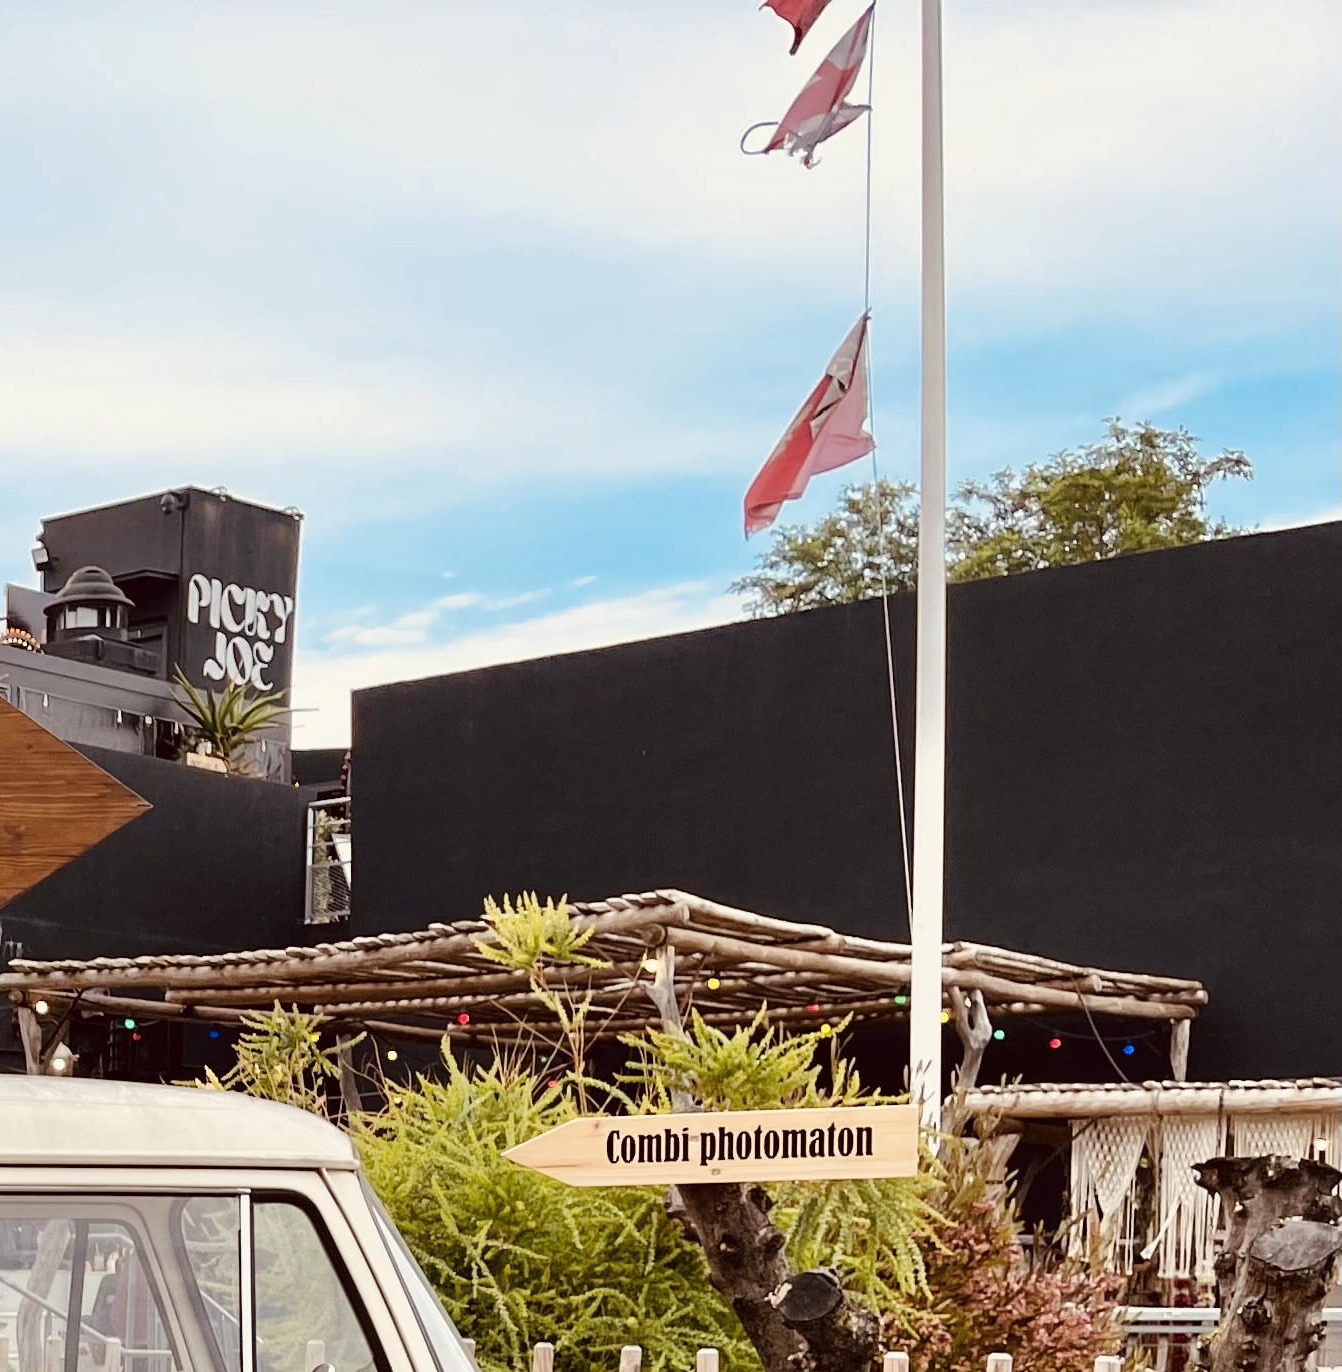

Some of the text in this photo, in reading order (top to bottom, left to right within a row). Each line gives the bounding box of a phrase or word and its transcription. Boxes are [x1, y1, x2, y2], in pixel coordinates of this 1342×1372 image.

[187, 573, 295, 692] PICKY JOE
[606, 1123, 873, 1166] Combi photomaton
